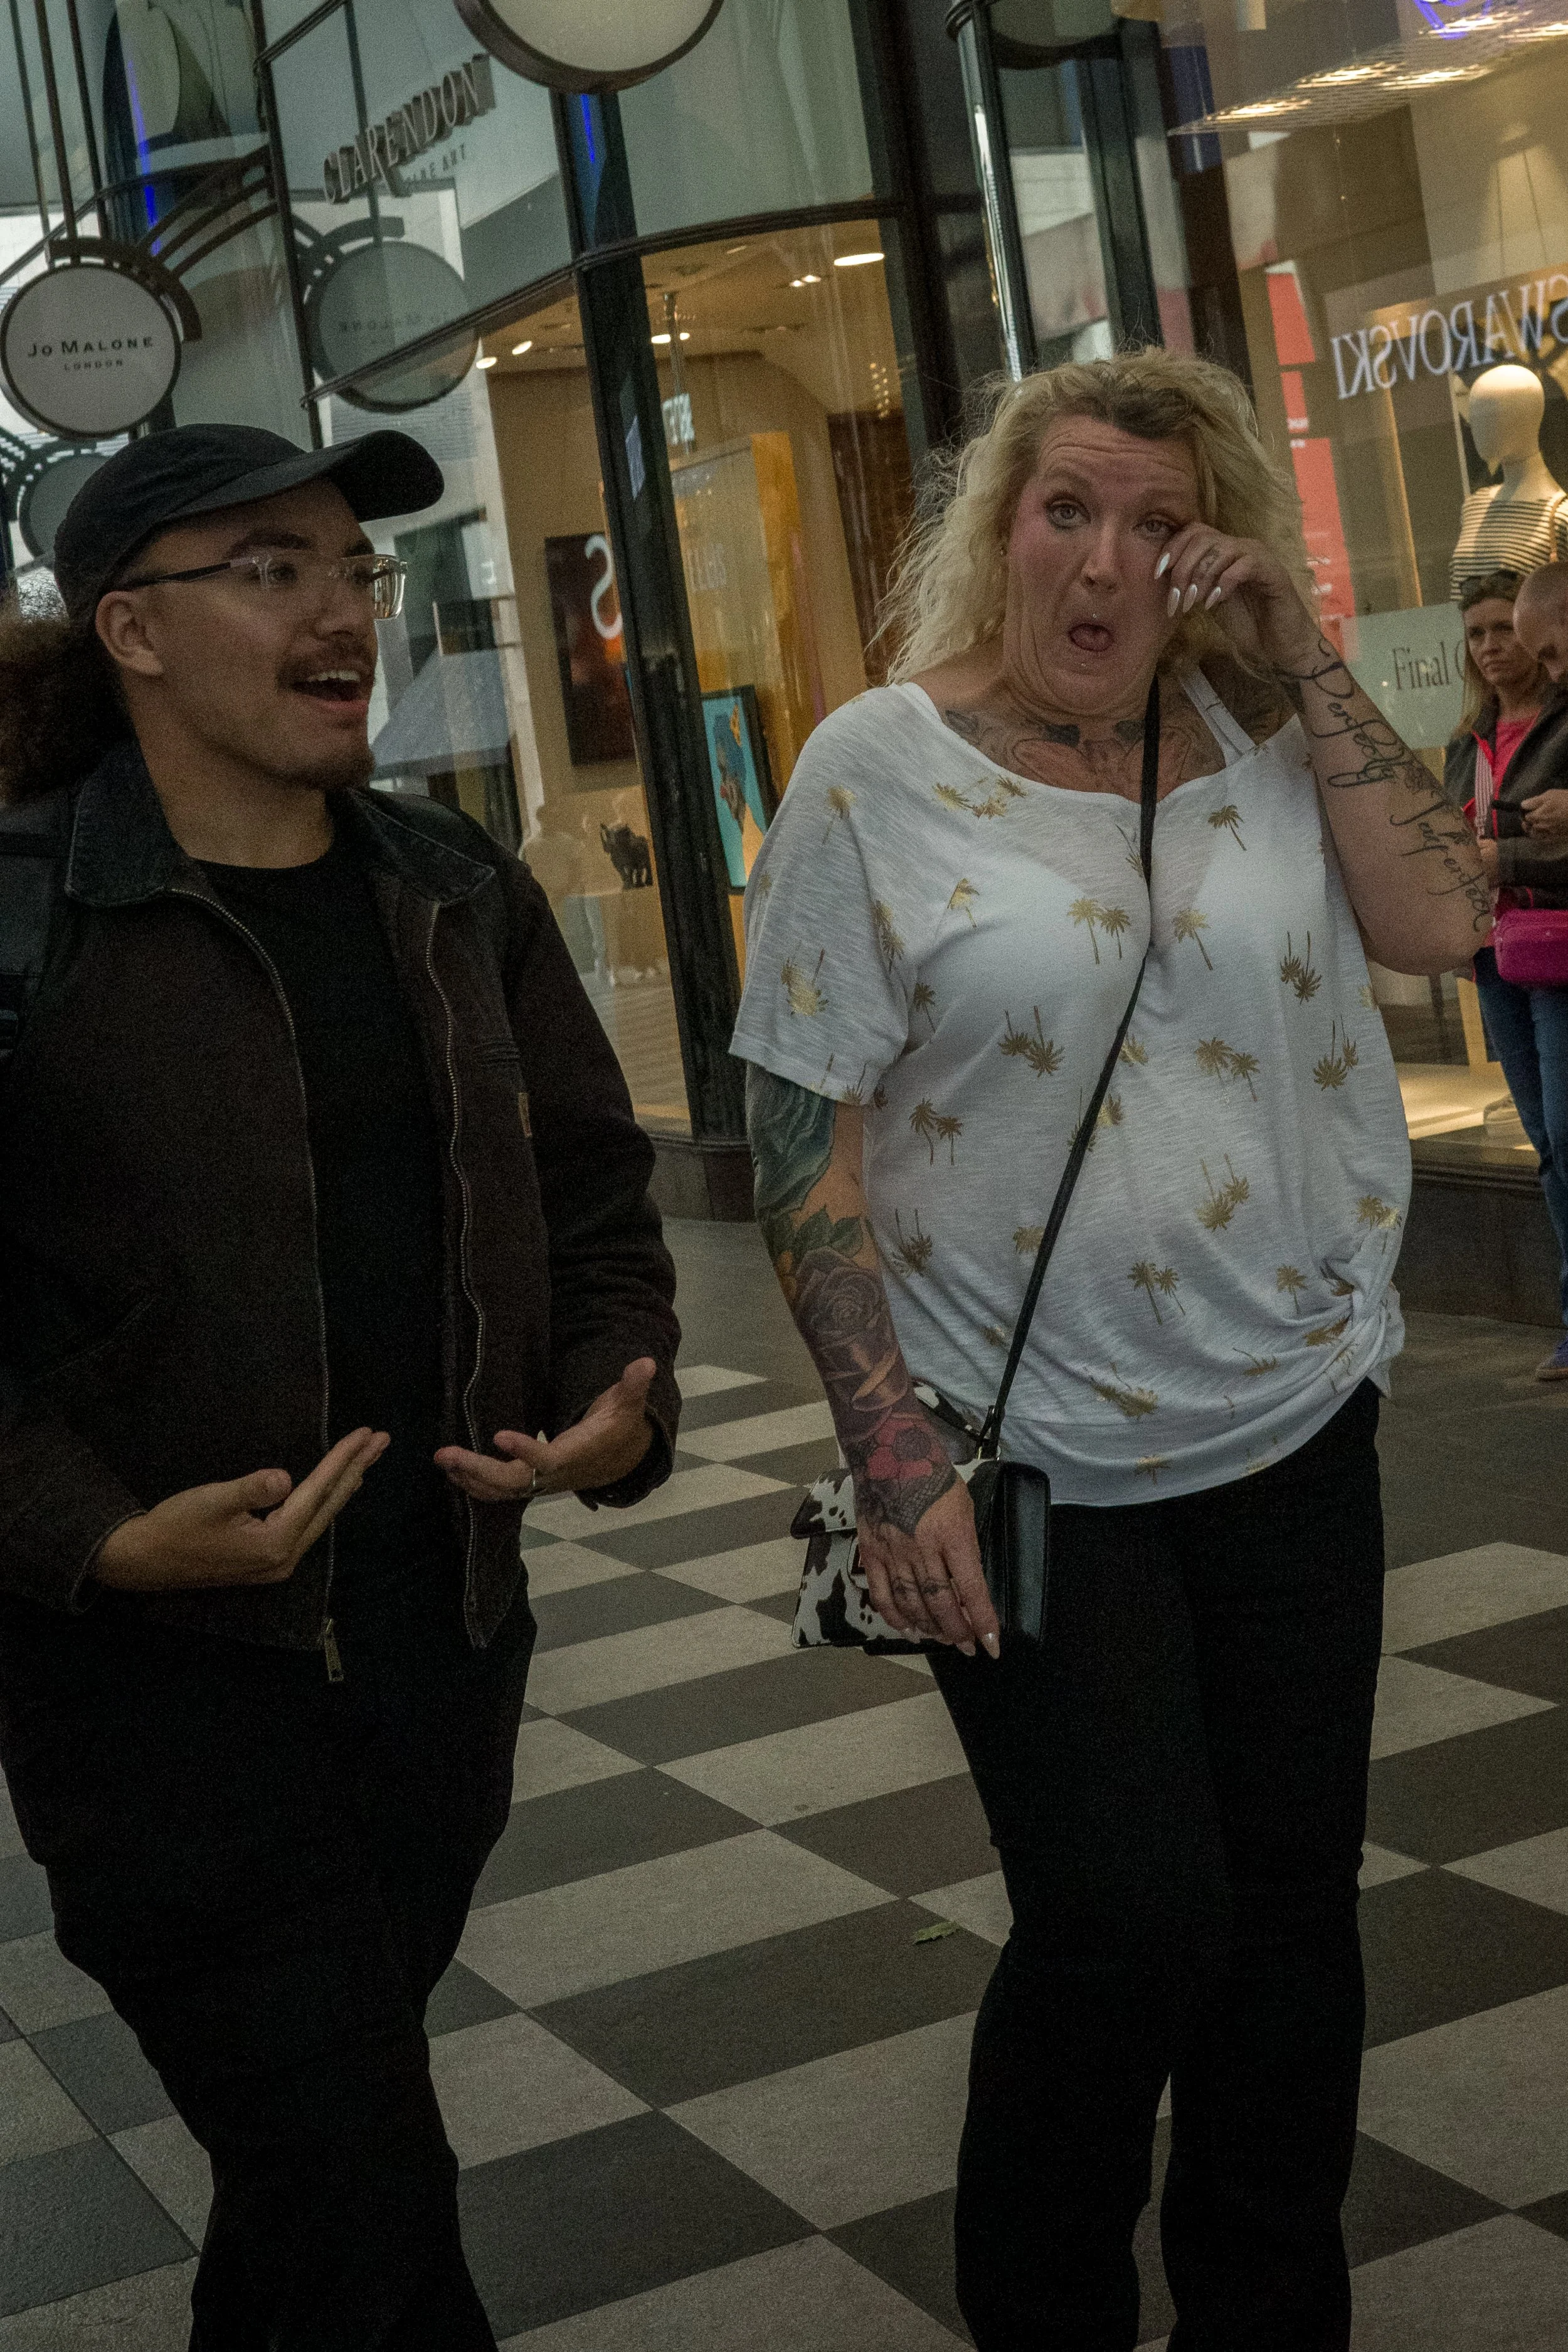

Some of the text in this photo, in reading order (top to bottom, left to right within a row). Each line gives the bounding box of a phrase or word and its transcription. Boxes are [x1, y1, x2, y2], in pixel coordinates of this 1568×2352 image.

[323, 54, 493, 205] CLARENDON
[60, 336, 154, 355] MALONE
[64, 359, 124, 371] LONDON
[1391, 640, 1452, 691] Final
